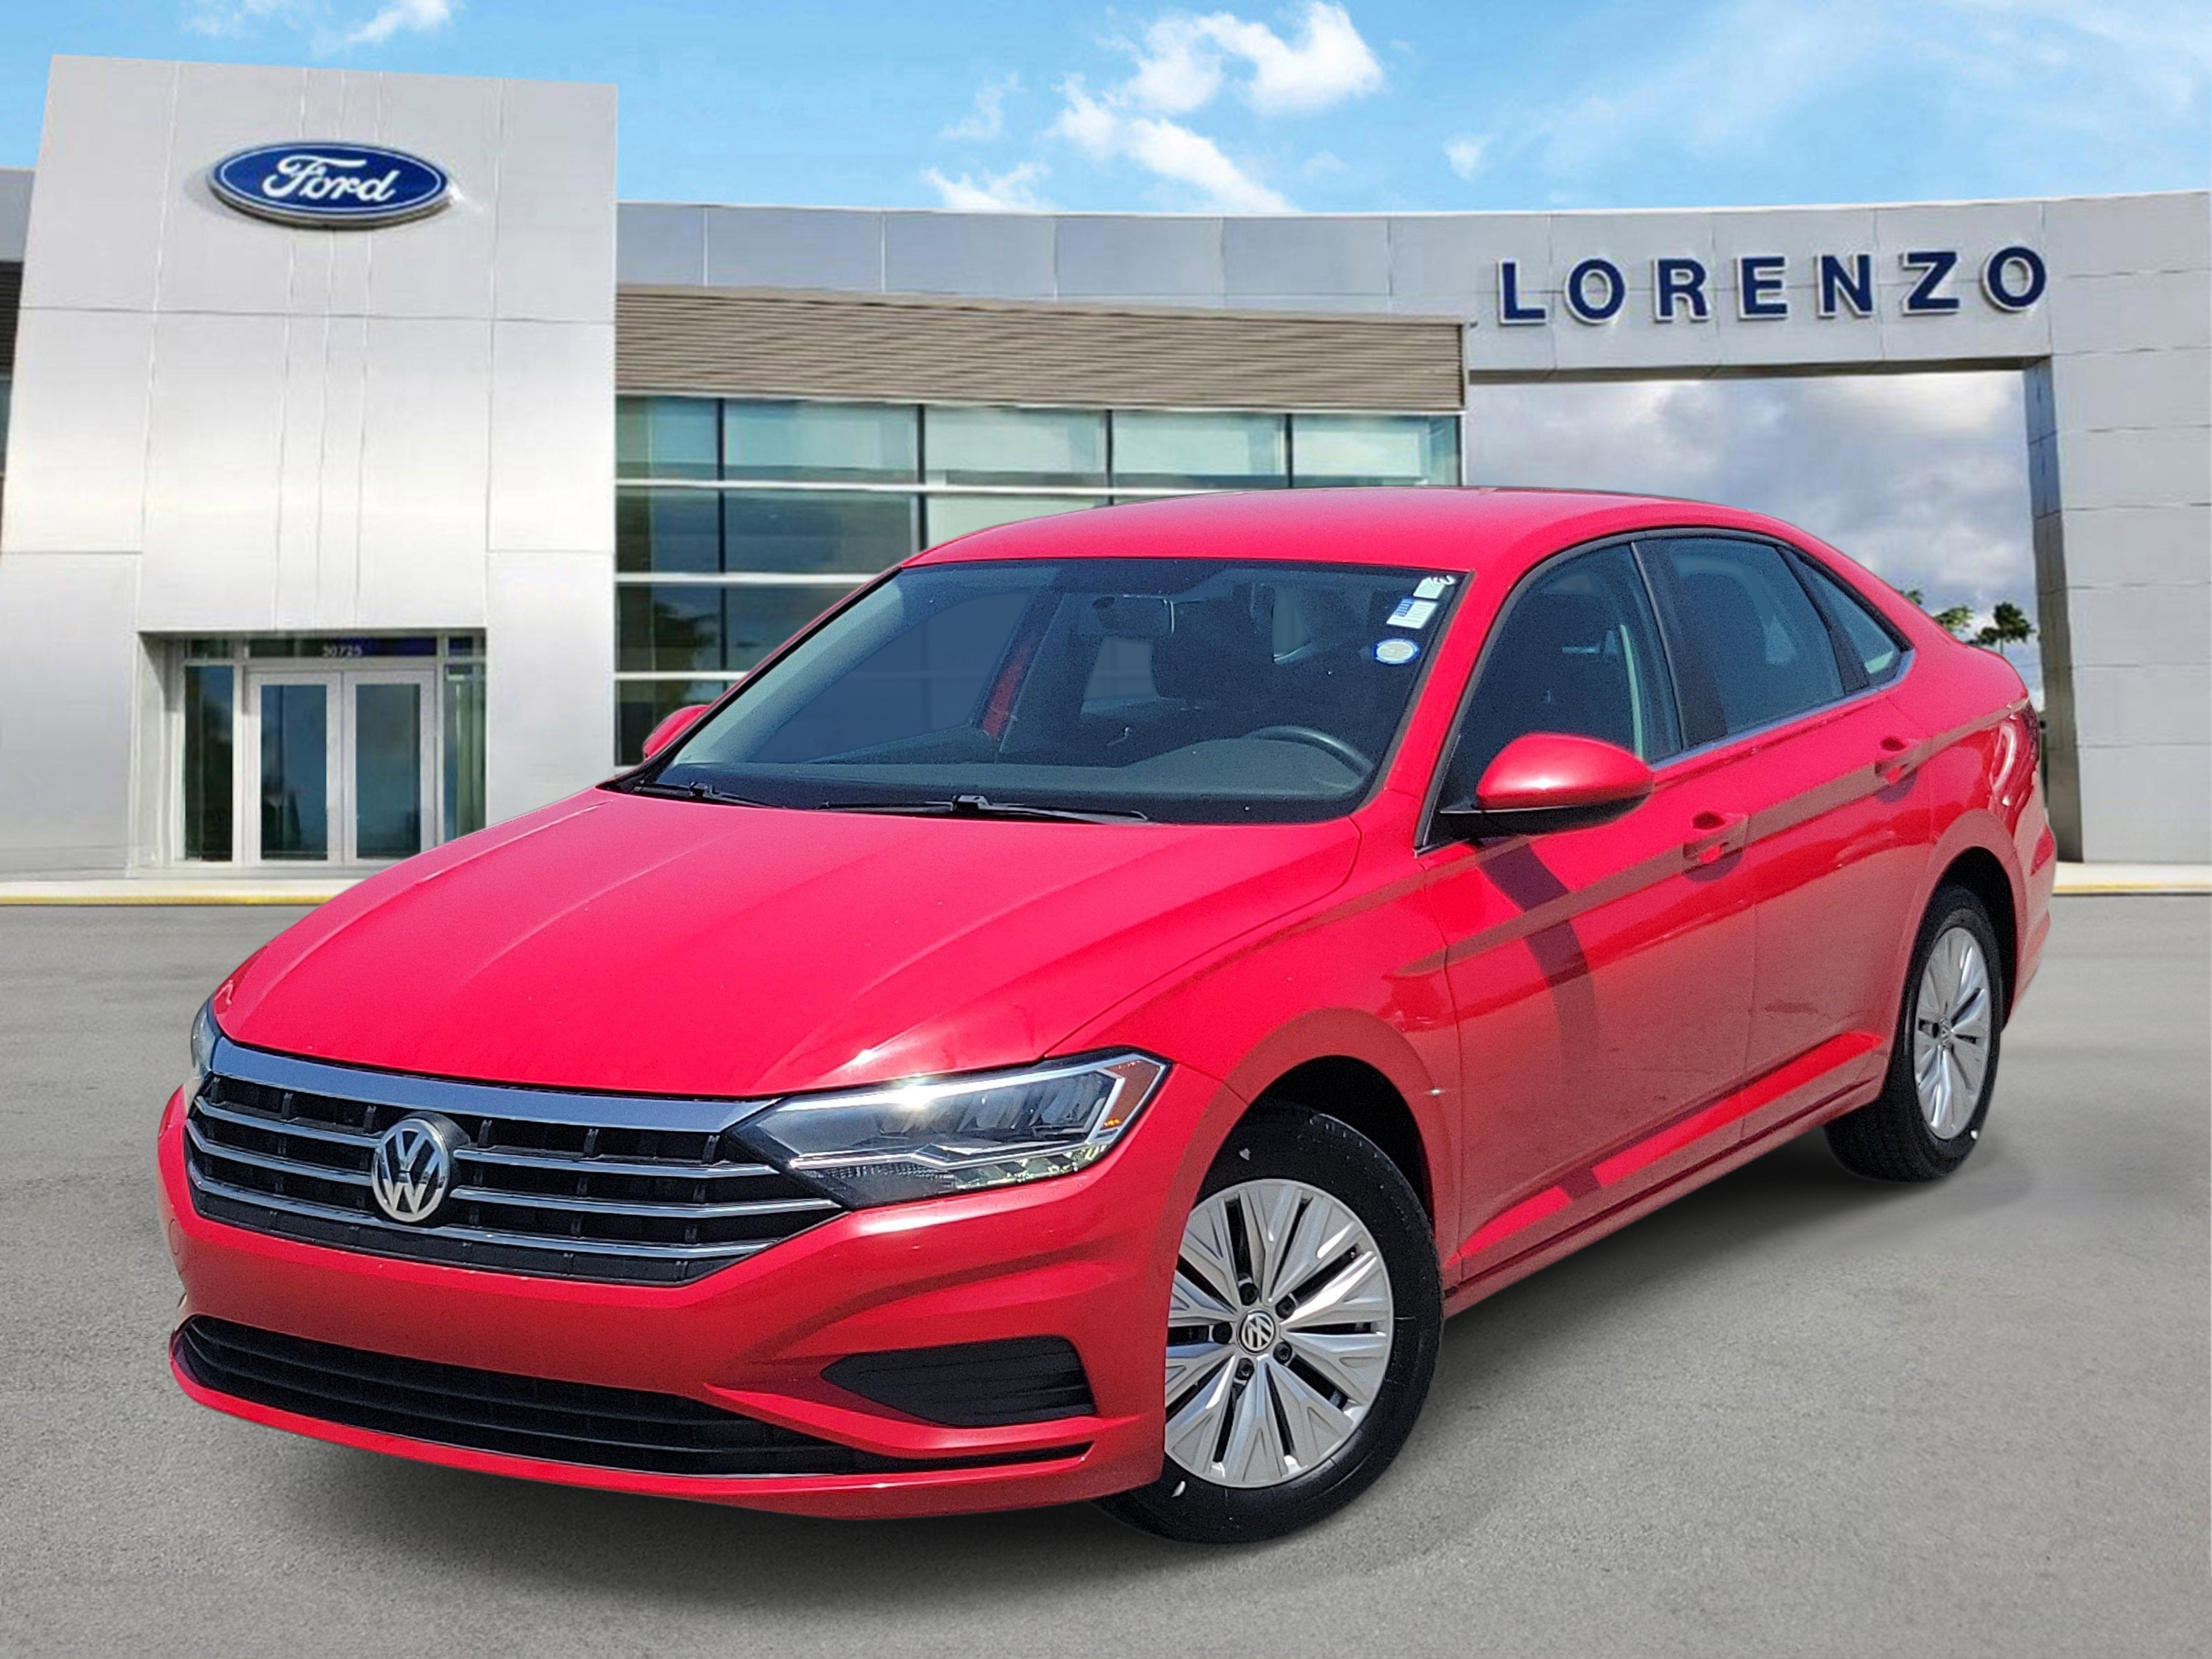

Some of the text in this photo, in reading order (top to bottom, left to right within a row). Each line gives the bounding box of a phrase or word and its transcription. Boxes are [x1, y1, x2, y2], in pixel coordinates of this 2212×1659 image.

[263, 155, 401, 201] Ford
[1499, 246, 2046, 323] LORENZO
[374, 1121, 447, 1220] VW
